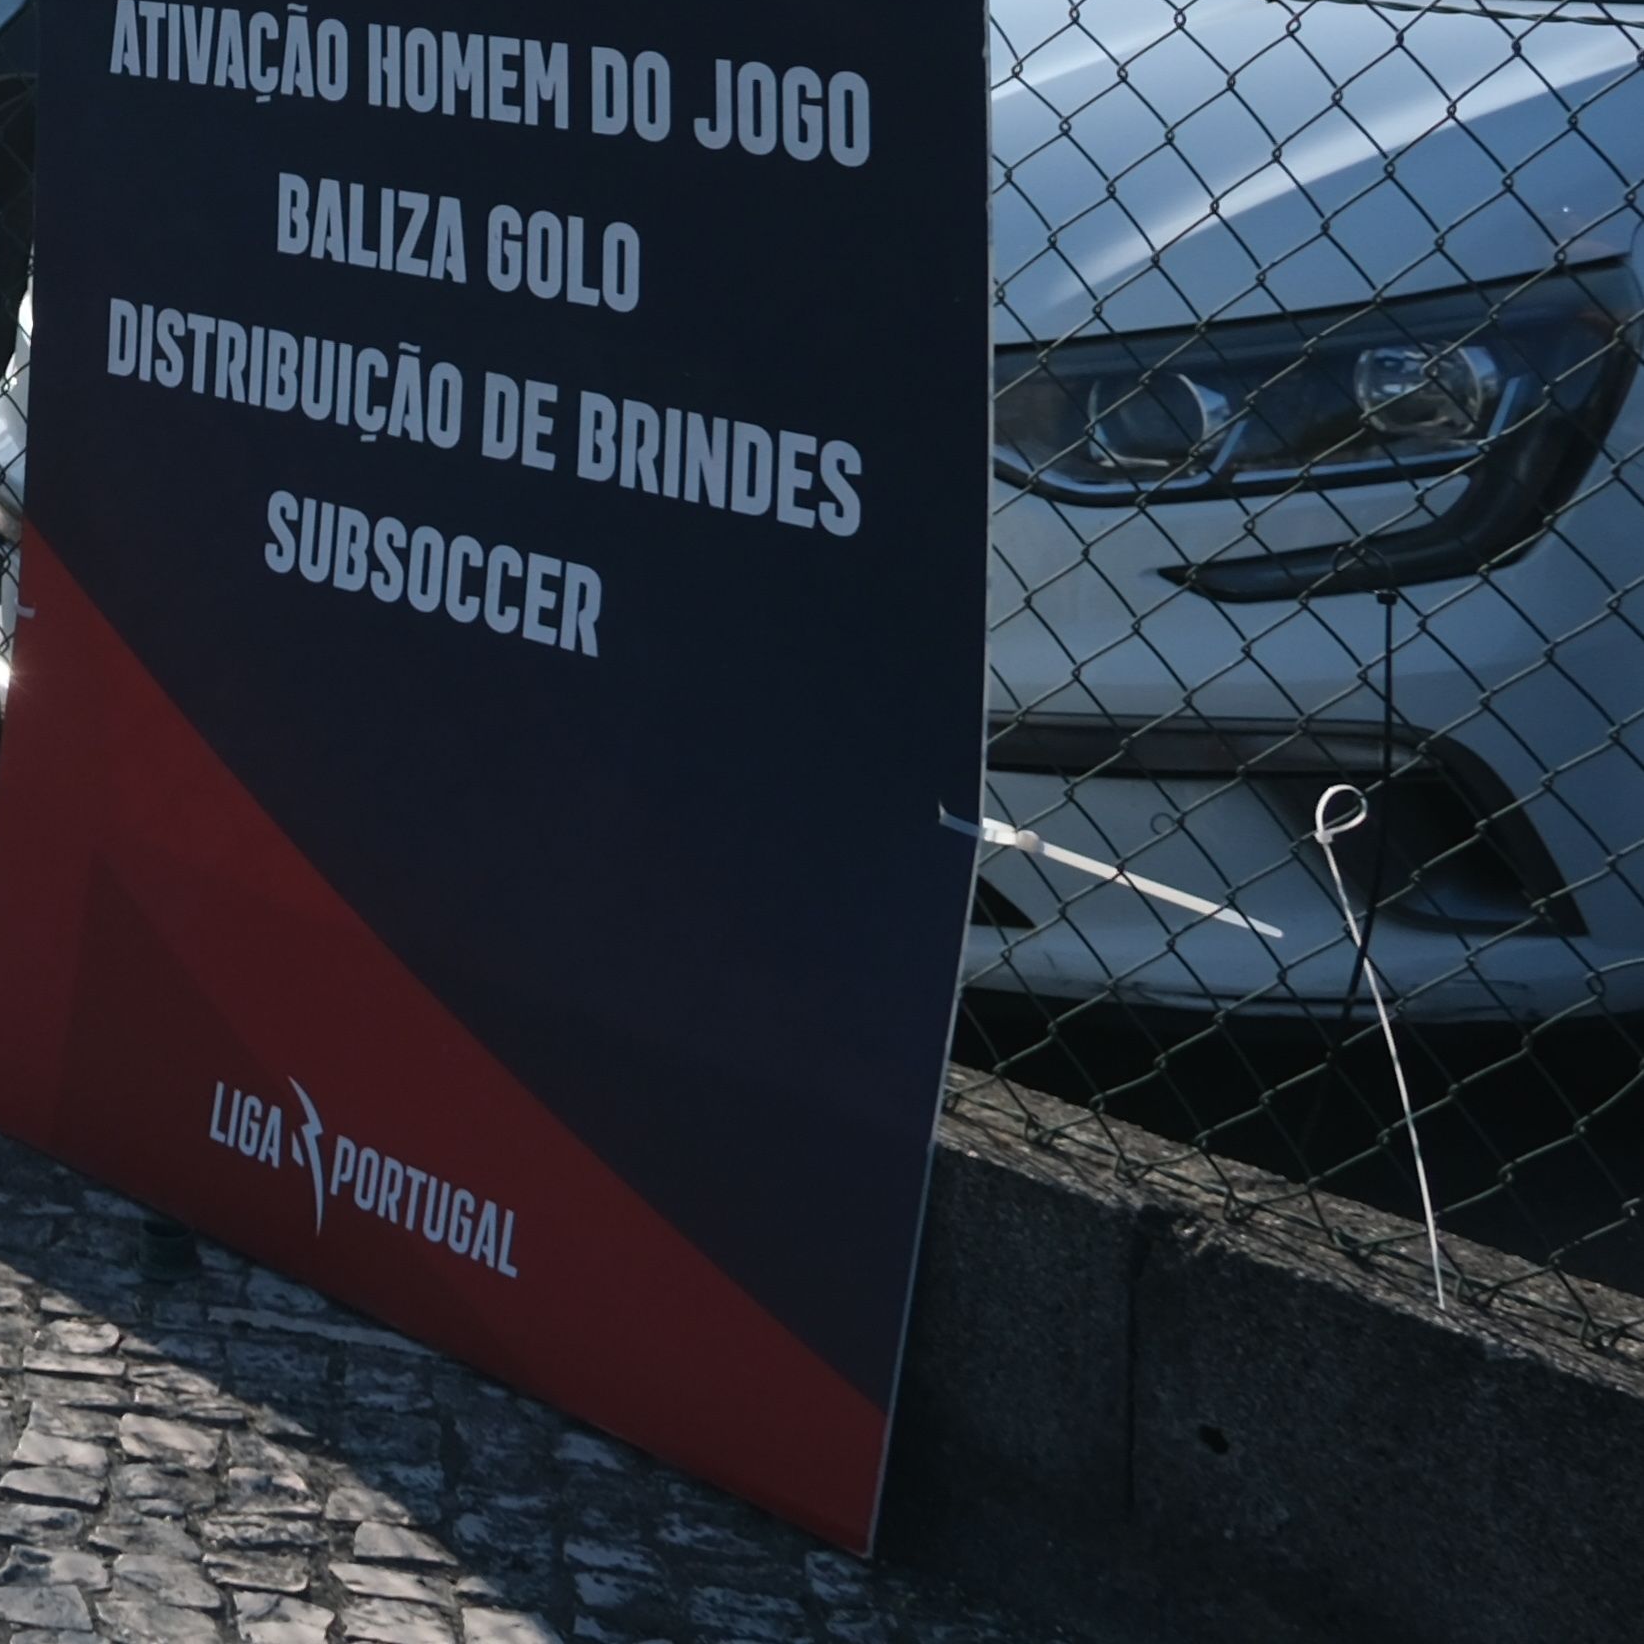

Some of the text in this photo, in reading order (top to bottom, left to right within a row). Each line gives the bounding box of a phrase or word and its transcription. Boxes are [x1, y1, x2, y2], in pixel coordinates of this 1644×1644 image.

[368, 23, 570, 129] HOMEM
[591, 46, 671, 142] DO
[693, 59, 871, 167] JOGO
[277, 172, 641, 313] BALIZA GOLO
[107, 297, 862, 537] DISTRIBUIÇÃO DE BRINDES
[264, 490, 602, 658] SUBSOCCER
[209, 1080, 518, 1279] LIGA PORTUGAL
